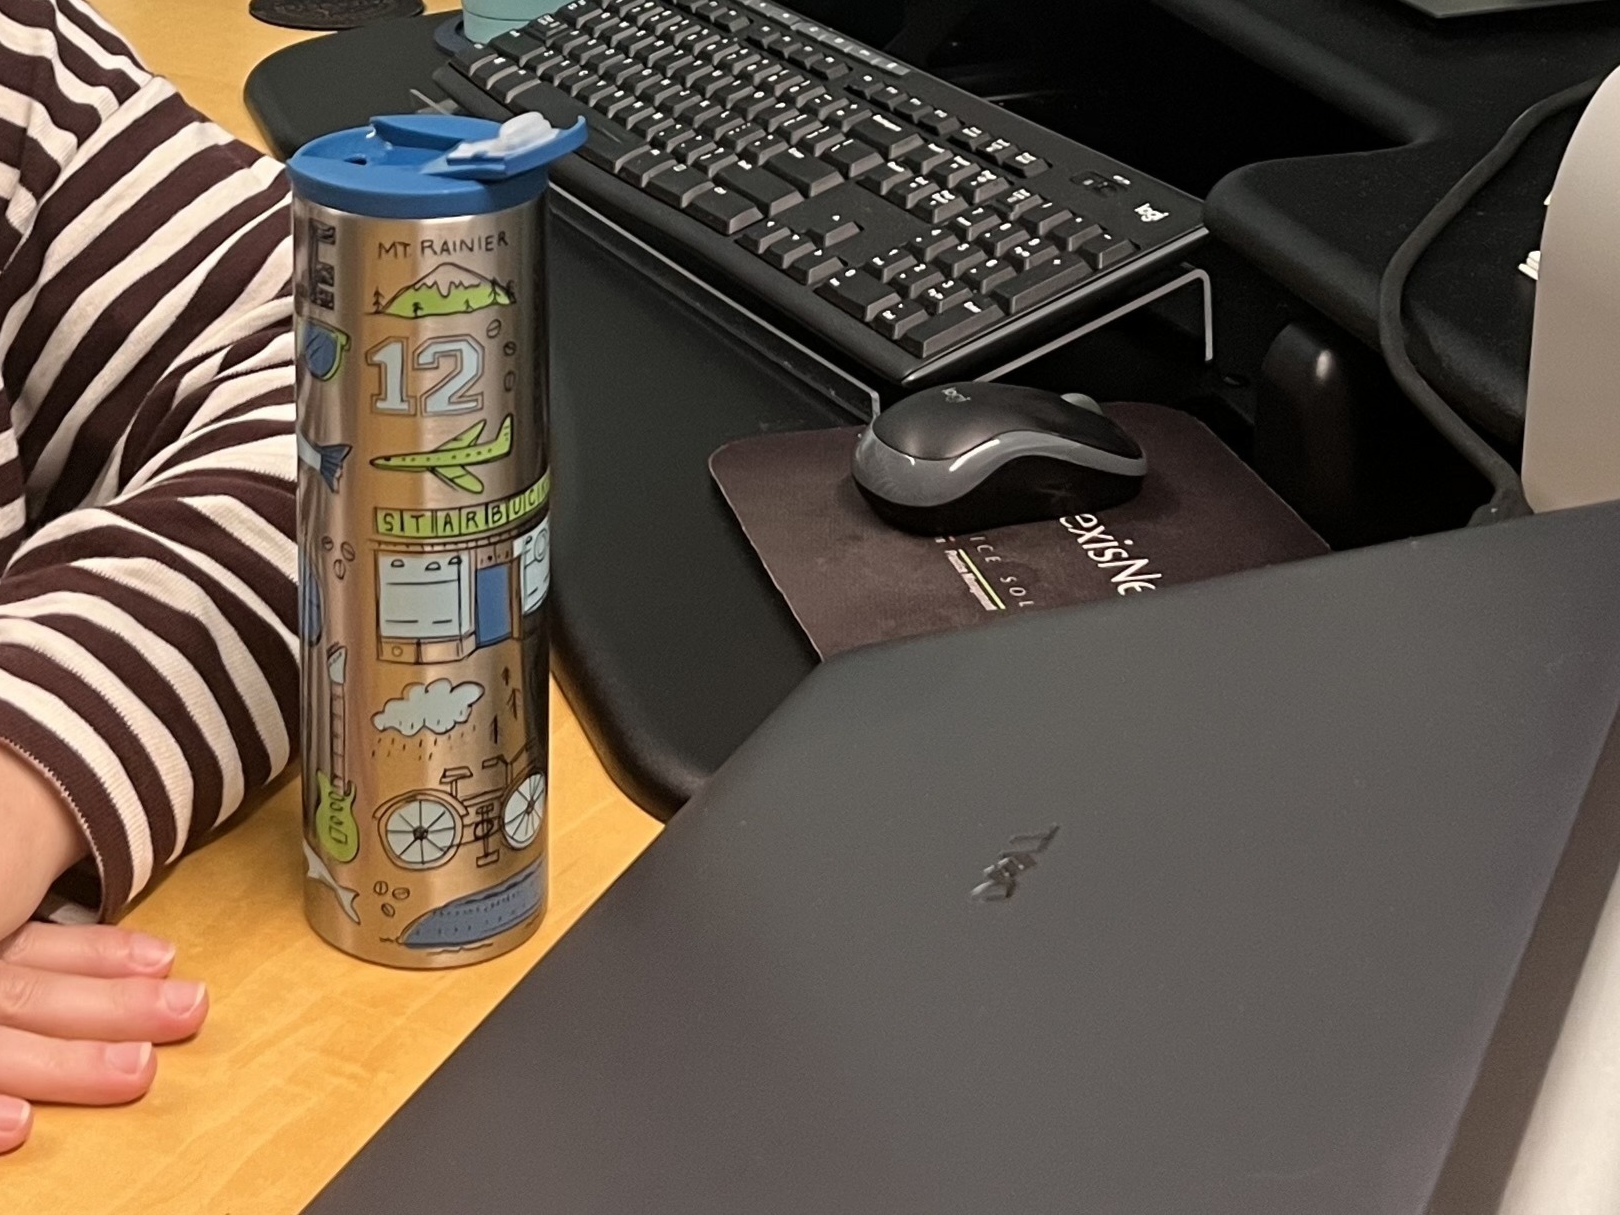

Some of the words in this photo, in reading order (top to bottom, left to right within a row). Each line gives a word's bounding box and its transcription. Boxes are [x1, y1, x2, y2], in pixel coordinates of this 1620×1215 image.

[420, 230, 510, 258] RAINIER
[365, 333, 485, 417] 12
[968, 535, 1002, 564] ICE
[1000, 575, 1035, 608] SOL
[1059, 513, 1163, 597] exisNe
